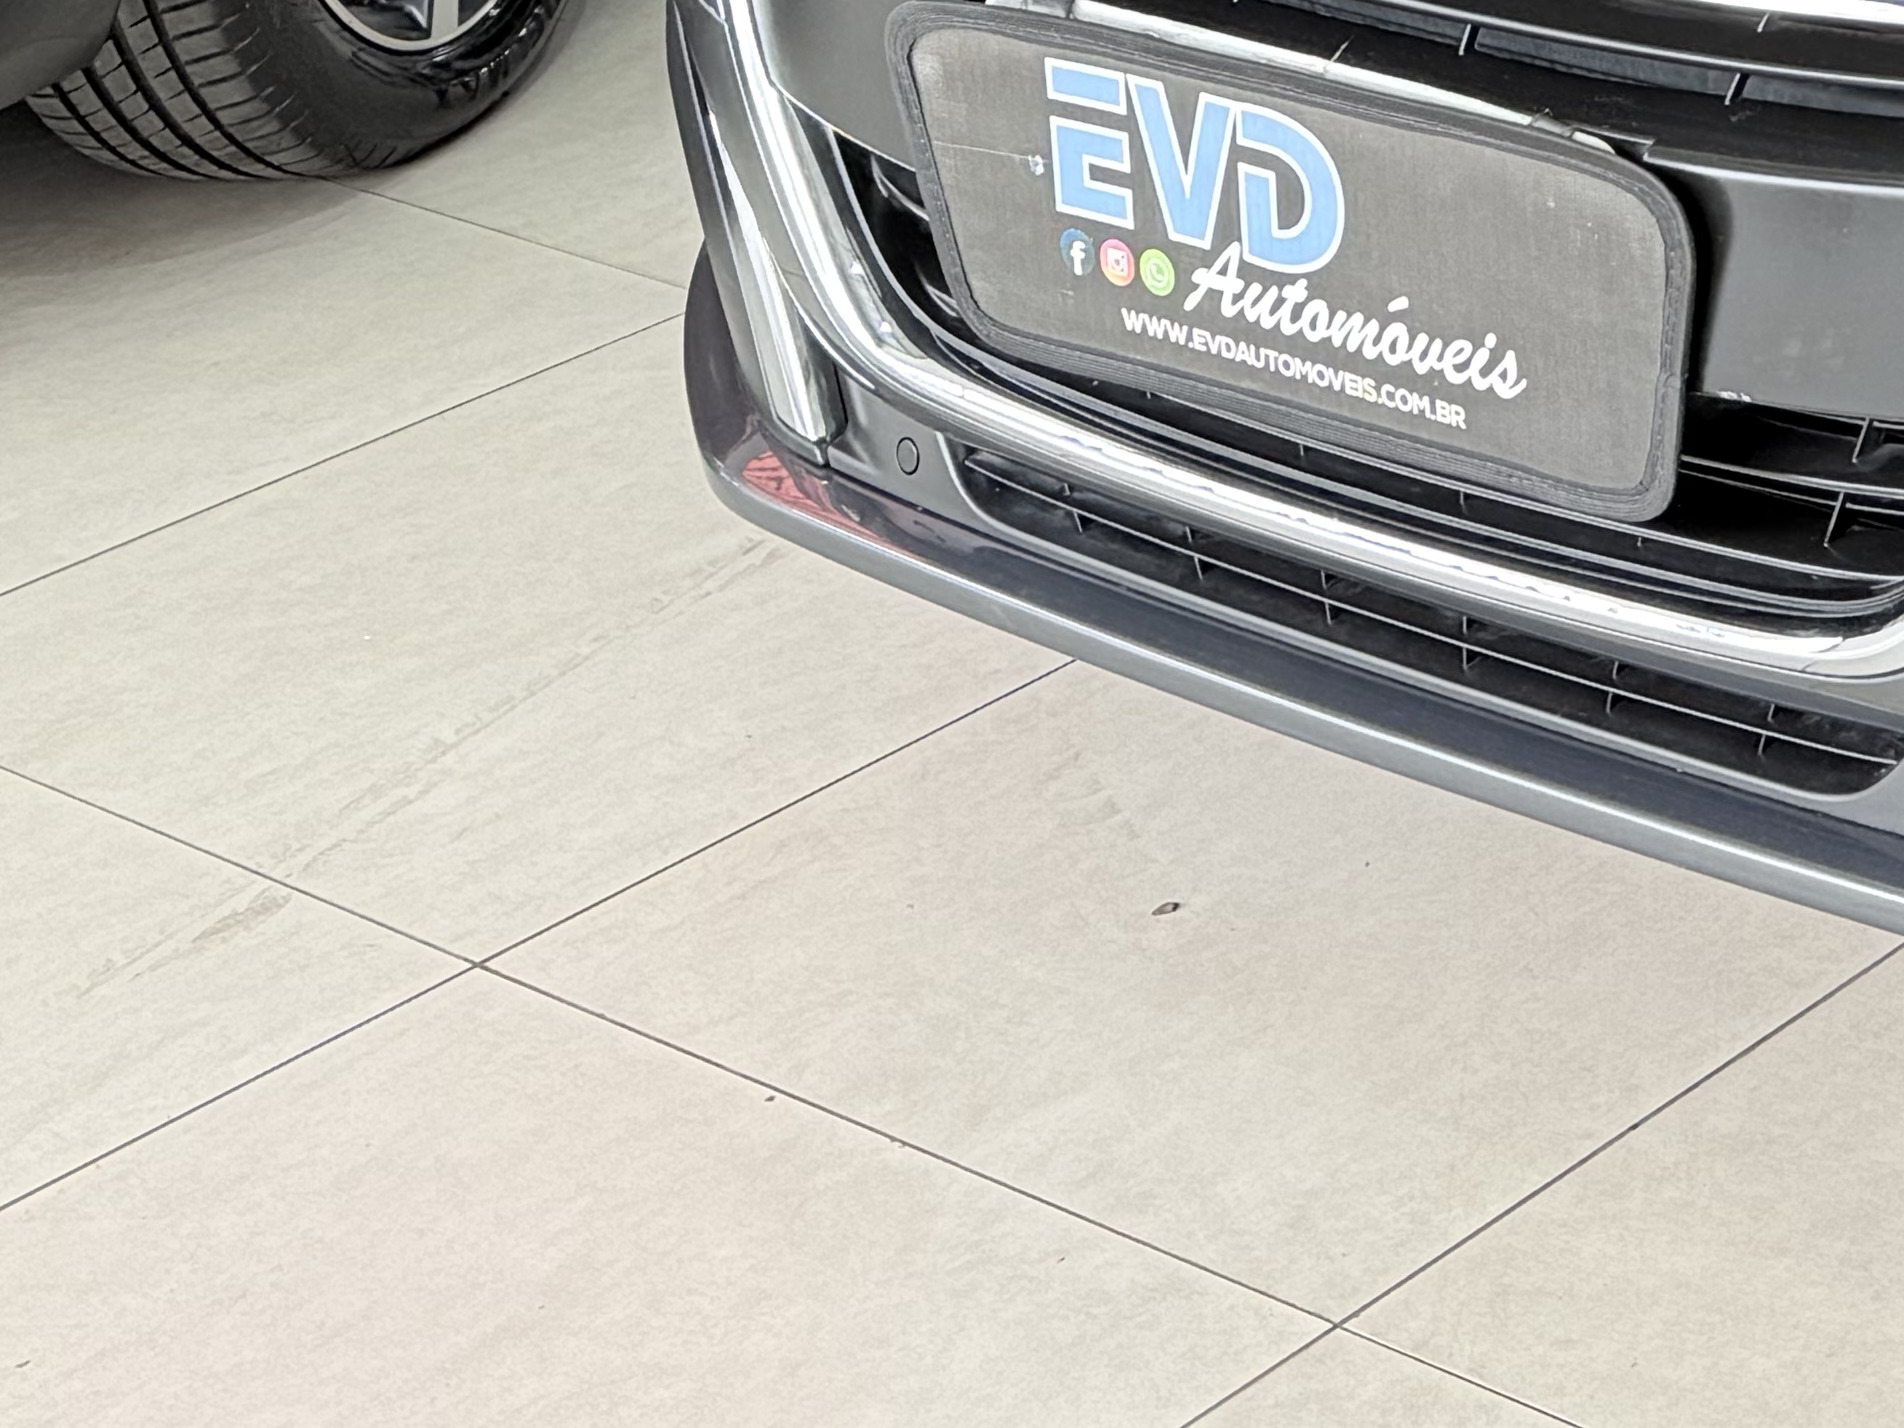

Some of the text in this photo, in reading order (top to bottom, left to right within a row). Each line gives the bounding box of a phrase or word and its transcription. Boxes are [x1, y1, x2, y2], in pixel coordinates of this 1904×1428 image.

[1043, 56, 1346, 275] EVD
[1120, 306, 1468, 430] WWW.EVDAUTOMOVEIS.COM.BR
[1183, 241, 1528, 401] Automóveis
